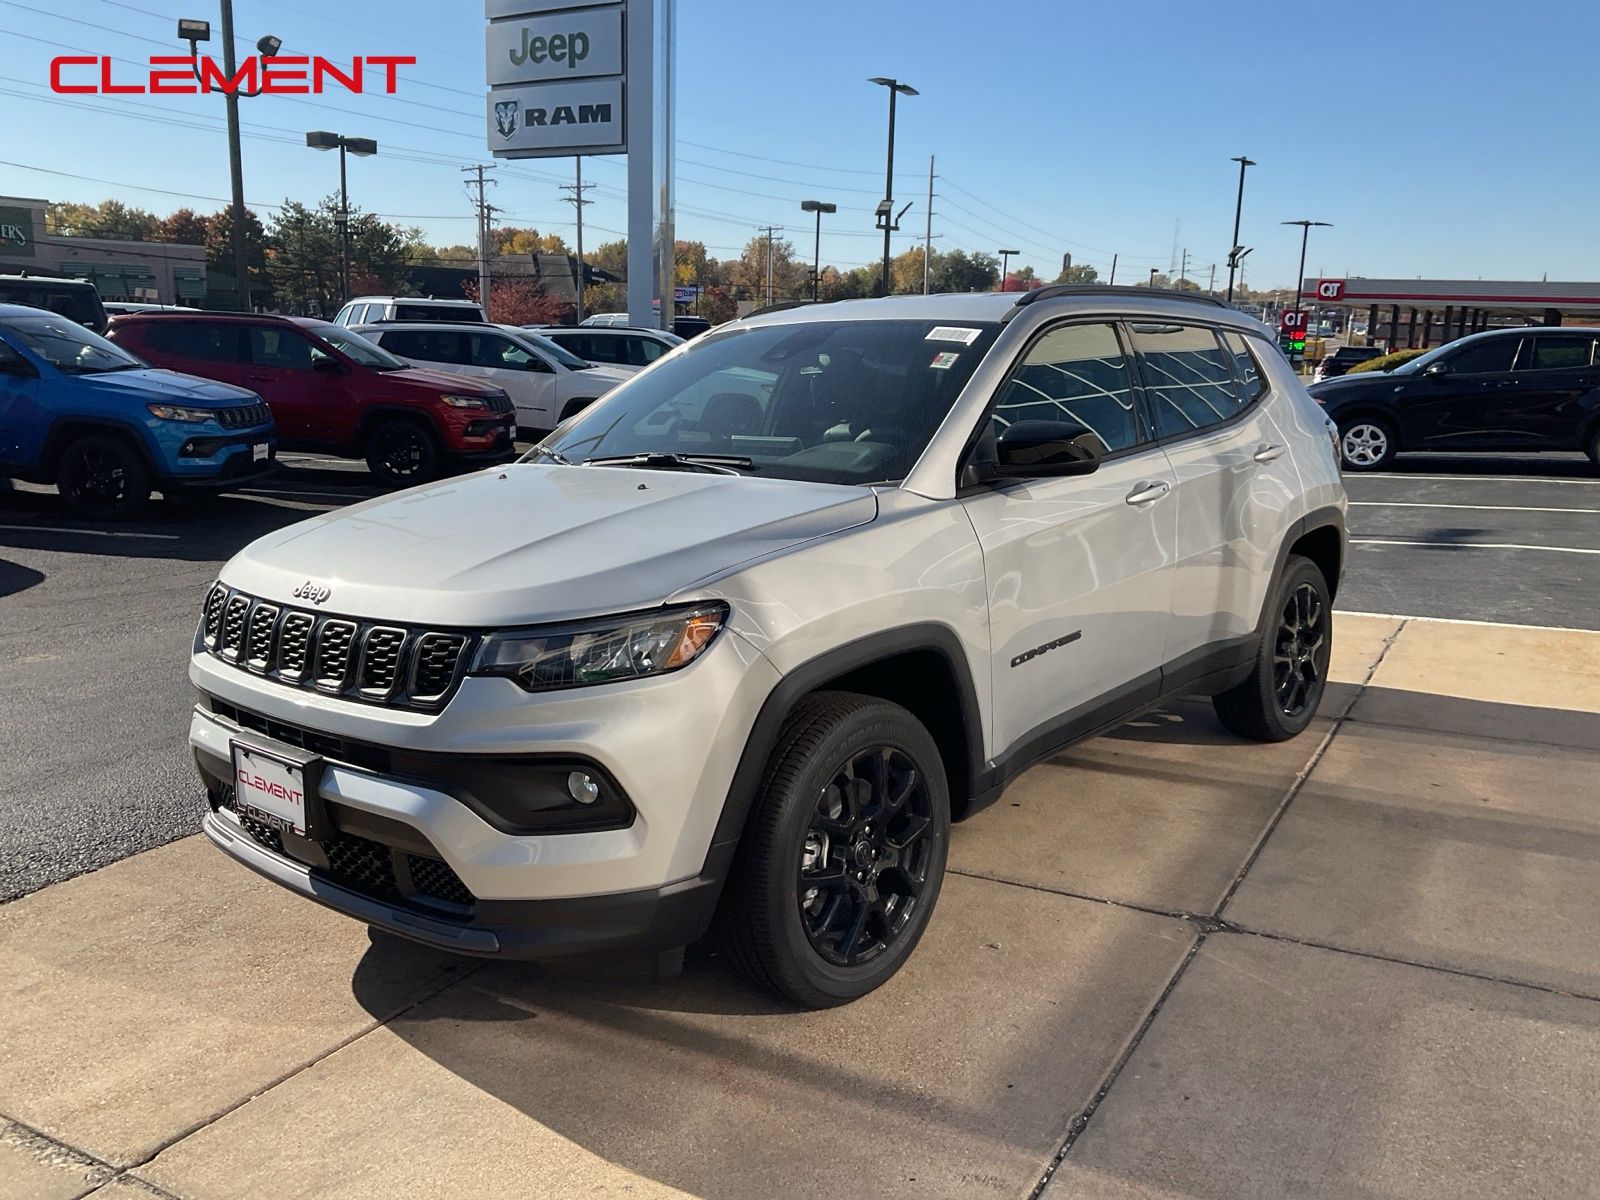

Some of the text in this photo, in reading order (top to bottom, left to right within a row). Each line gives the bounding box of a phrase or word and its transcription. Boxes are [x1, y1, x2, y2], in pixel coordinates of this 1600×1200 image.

[509, 28, 590, 69] Jeep
[525, 104, 611, 127] RAM
[1320, 283, 1341, 297] QT
[1284, 313, 1304, 326] QT
[293, 580, 332, 606] Jeep
[238, 769, 303, 806] CLEMENT
